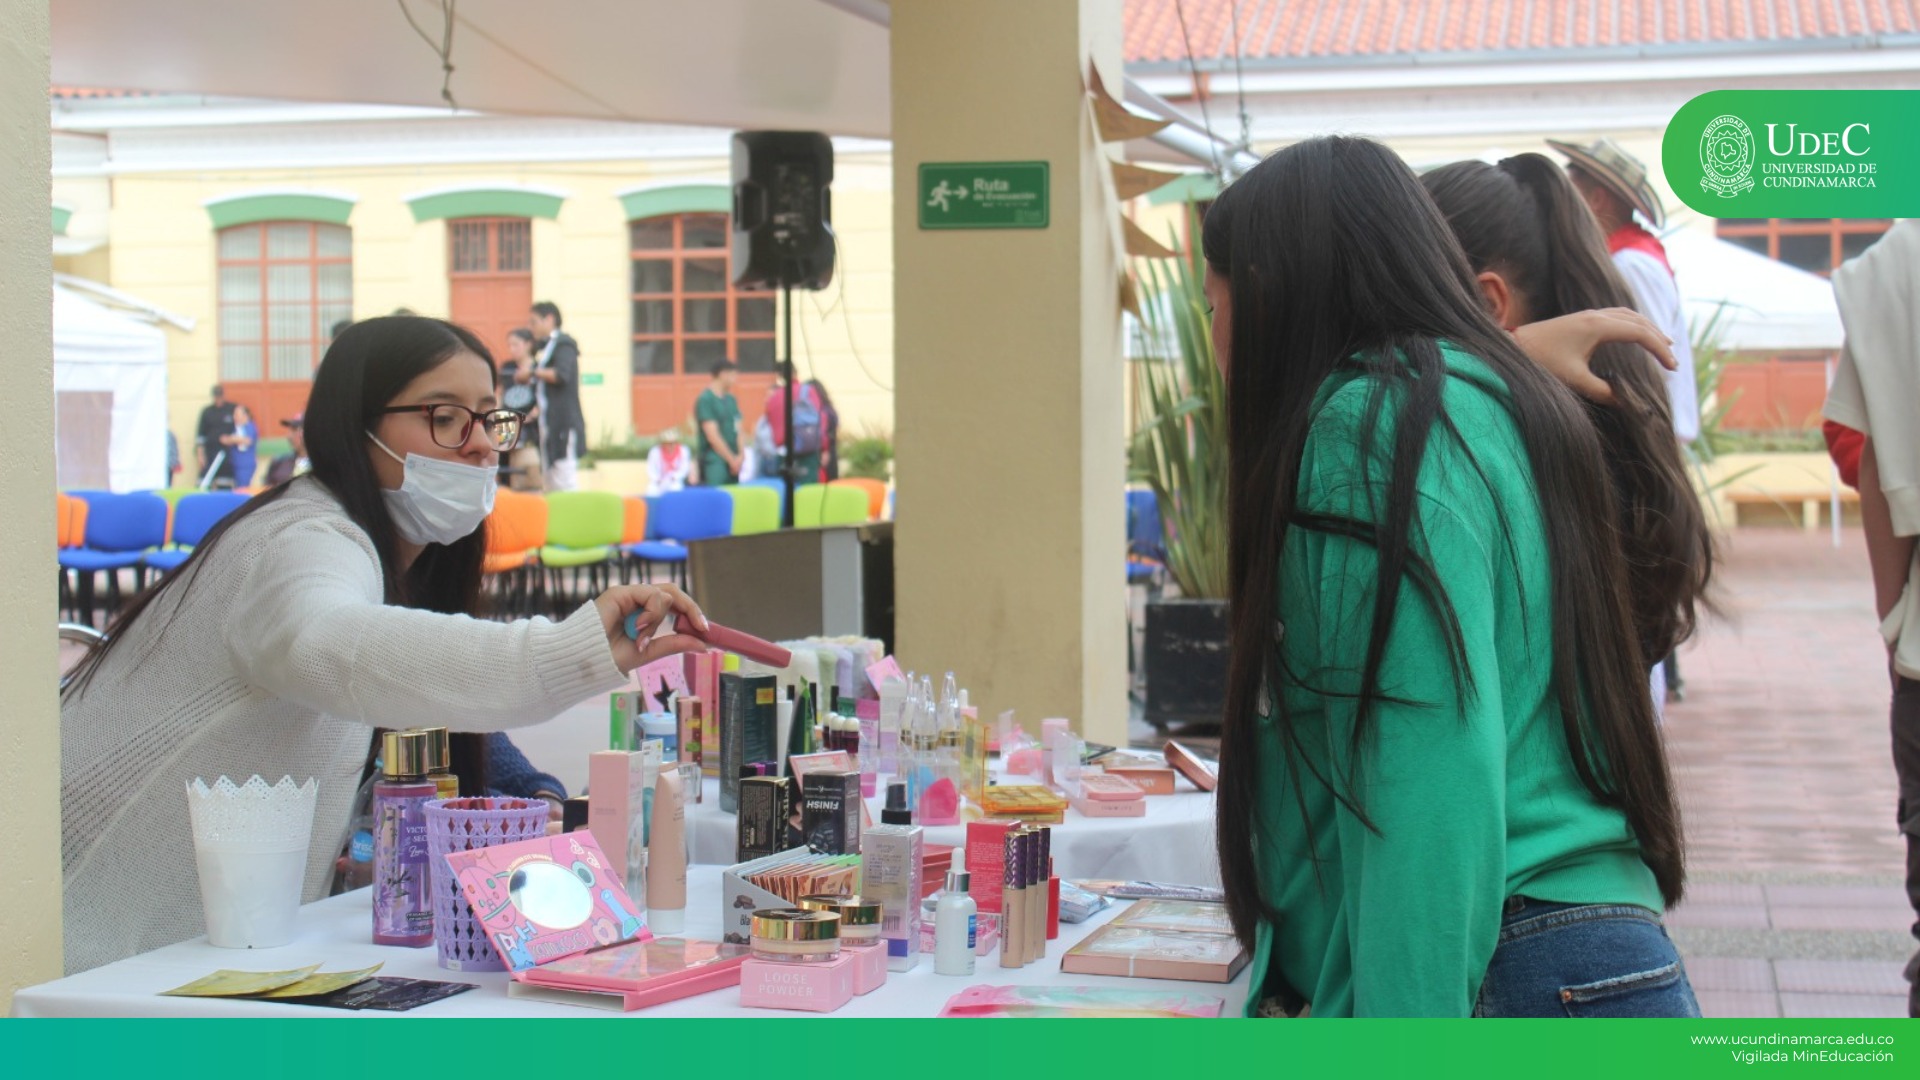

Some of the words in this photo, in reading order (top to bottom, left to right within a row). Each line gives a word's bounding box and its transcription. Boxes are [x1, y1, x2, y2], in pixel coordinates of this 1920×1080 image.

[973, 178, 1009, 191] Ruta
[806, 800, 839, 810] FINISH
[764, 972, 808, 985] LOOSE
[758, 984, 814, 997] POWDER
